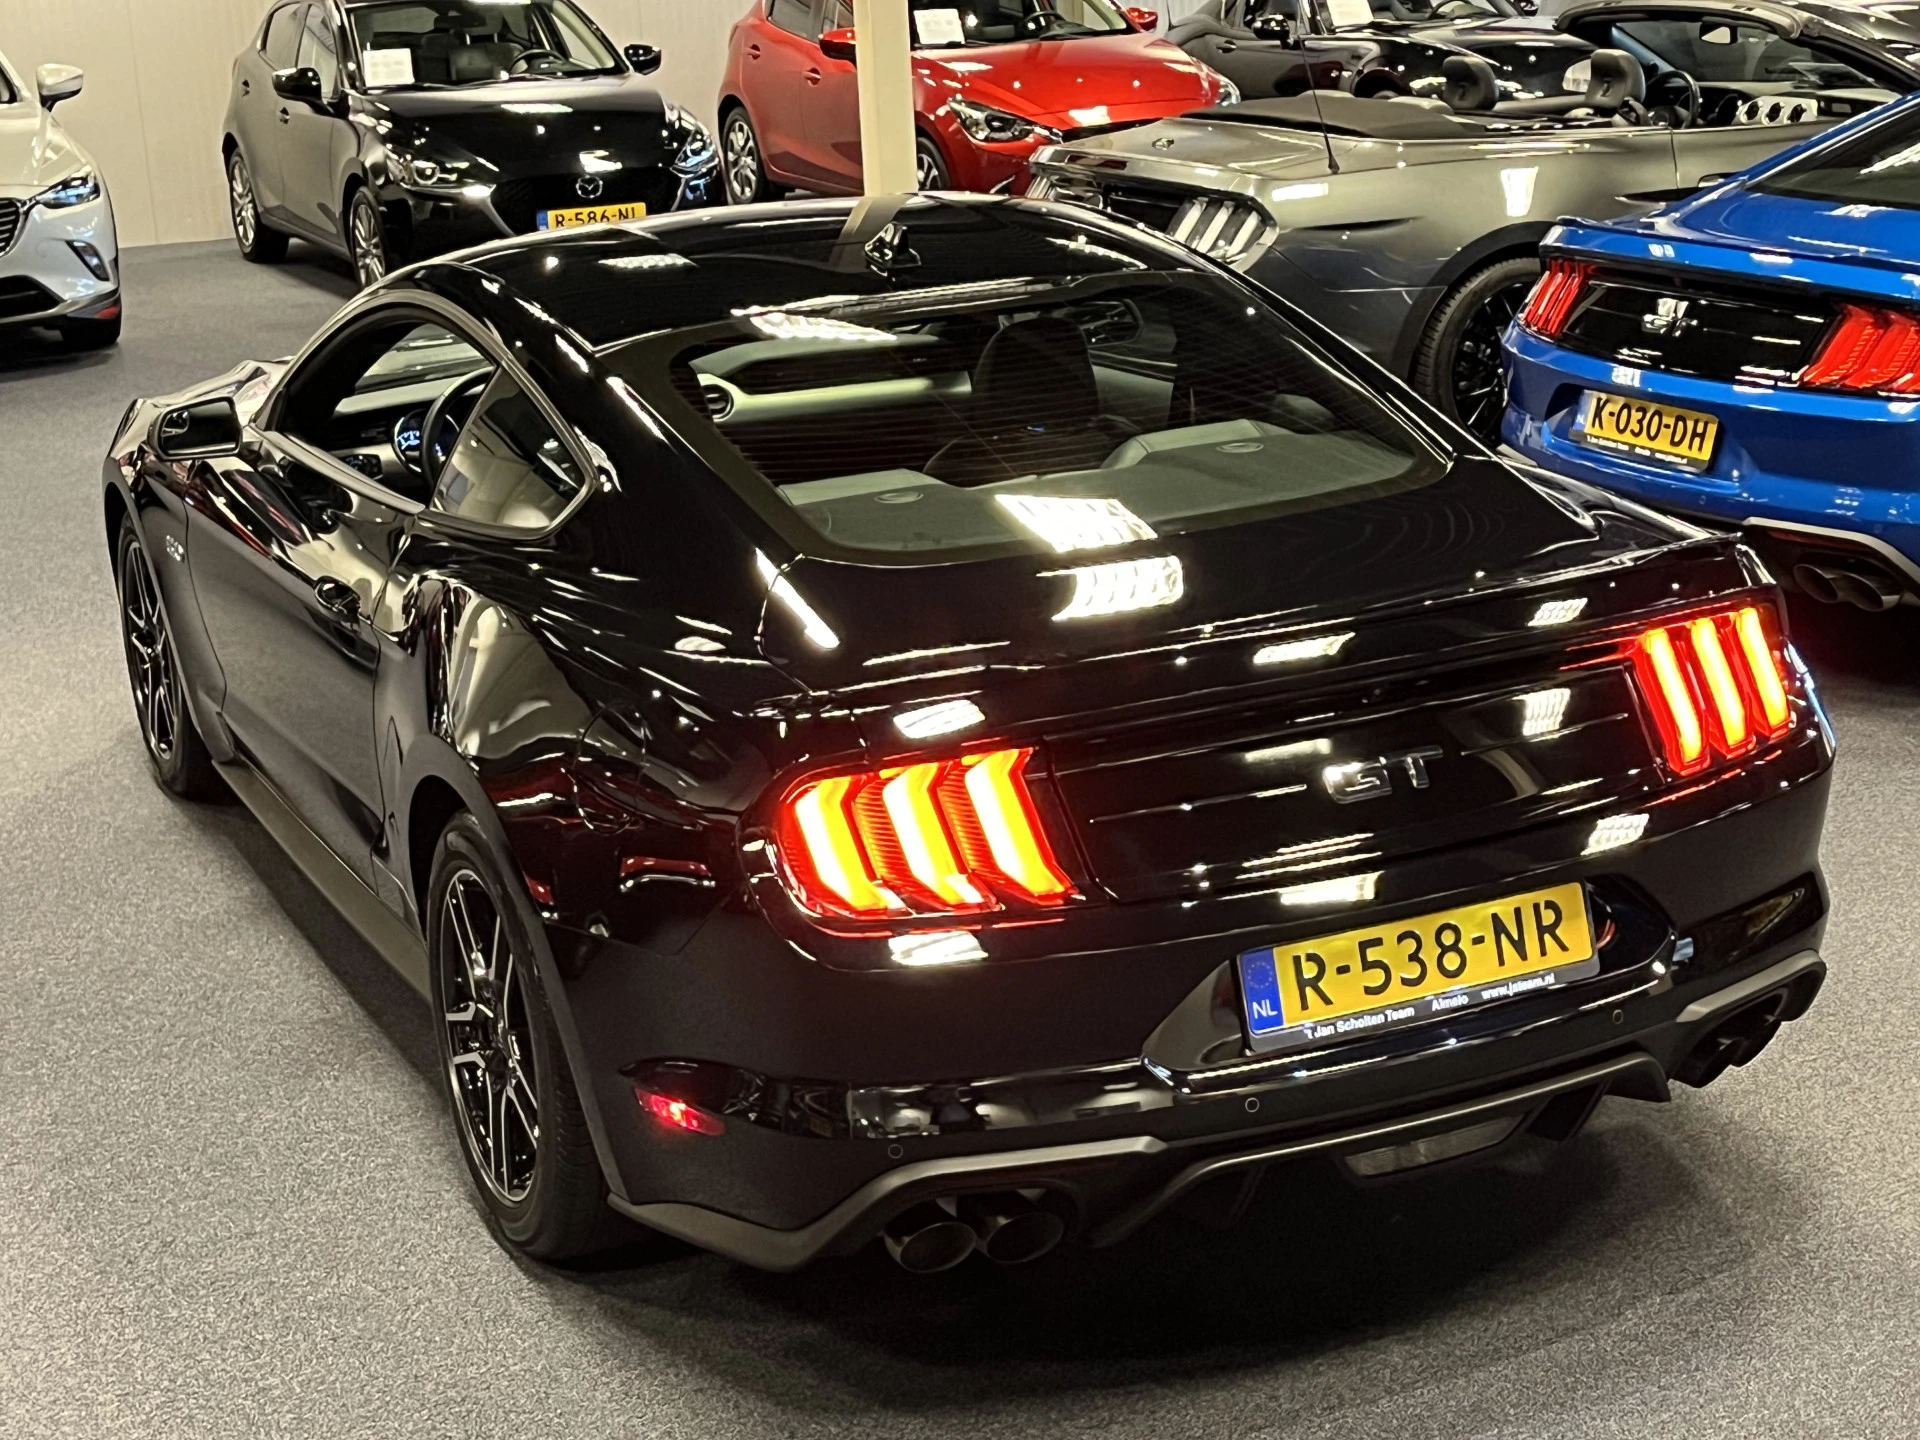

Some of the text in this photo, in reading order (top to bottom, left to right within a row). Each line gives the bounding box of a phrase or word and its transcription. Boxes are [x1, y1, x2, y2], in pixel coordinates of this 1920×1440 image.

[1591, 396, 1709, 453] K-030-DH
[1322, 745, 1443, 804] GT
[1293, 900, 1570, 1011] R-538-NR
[1252, 999, 1278, 1019] NL
[1314, 1024, 1335, 1039] Jan
[1385, 1006, 1415, 1021] Team
[1432, 994, 1469, 1011] Almelo
